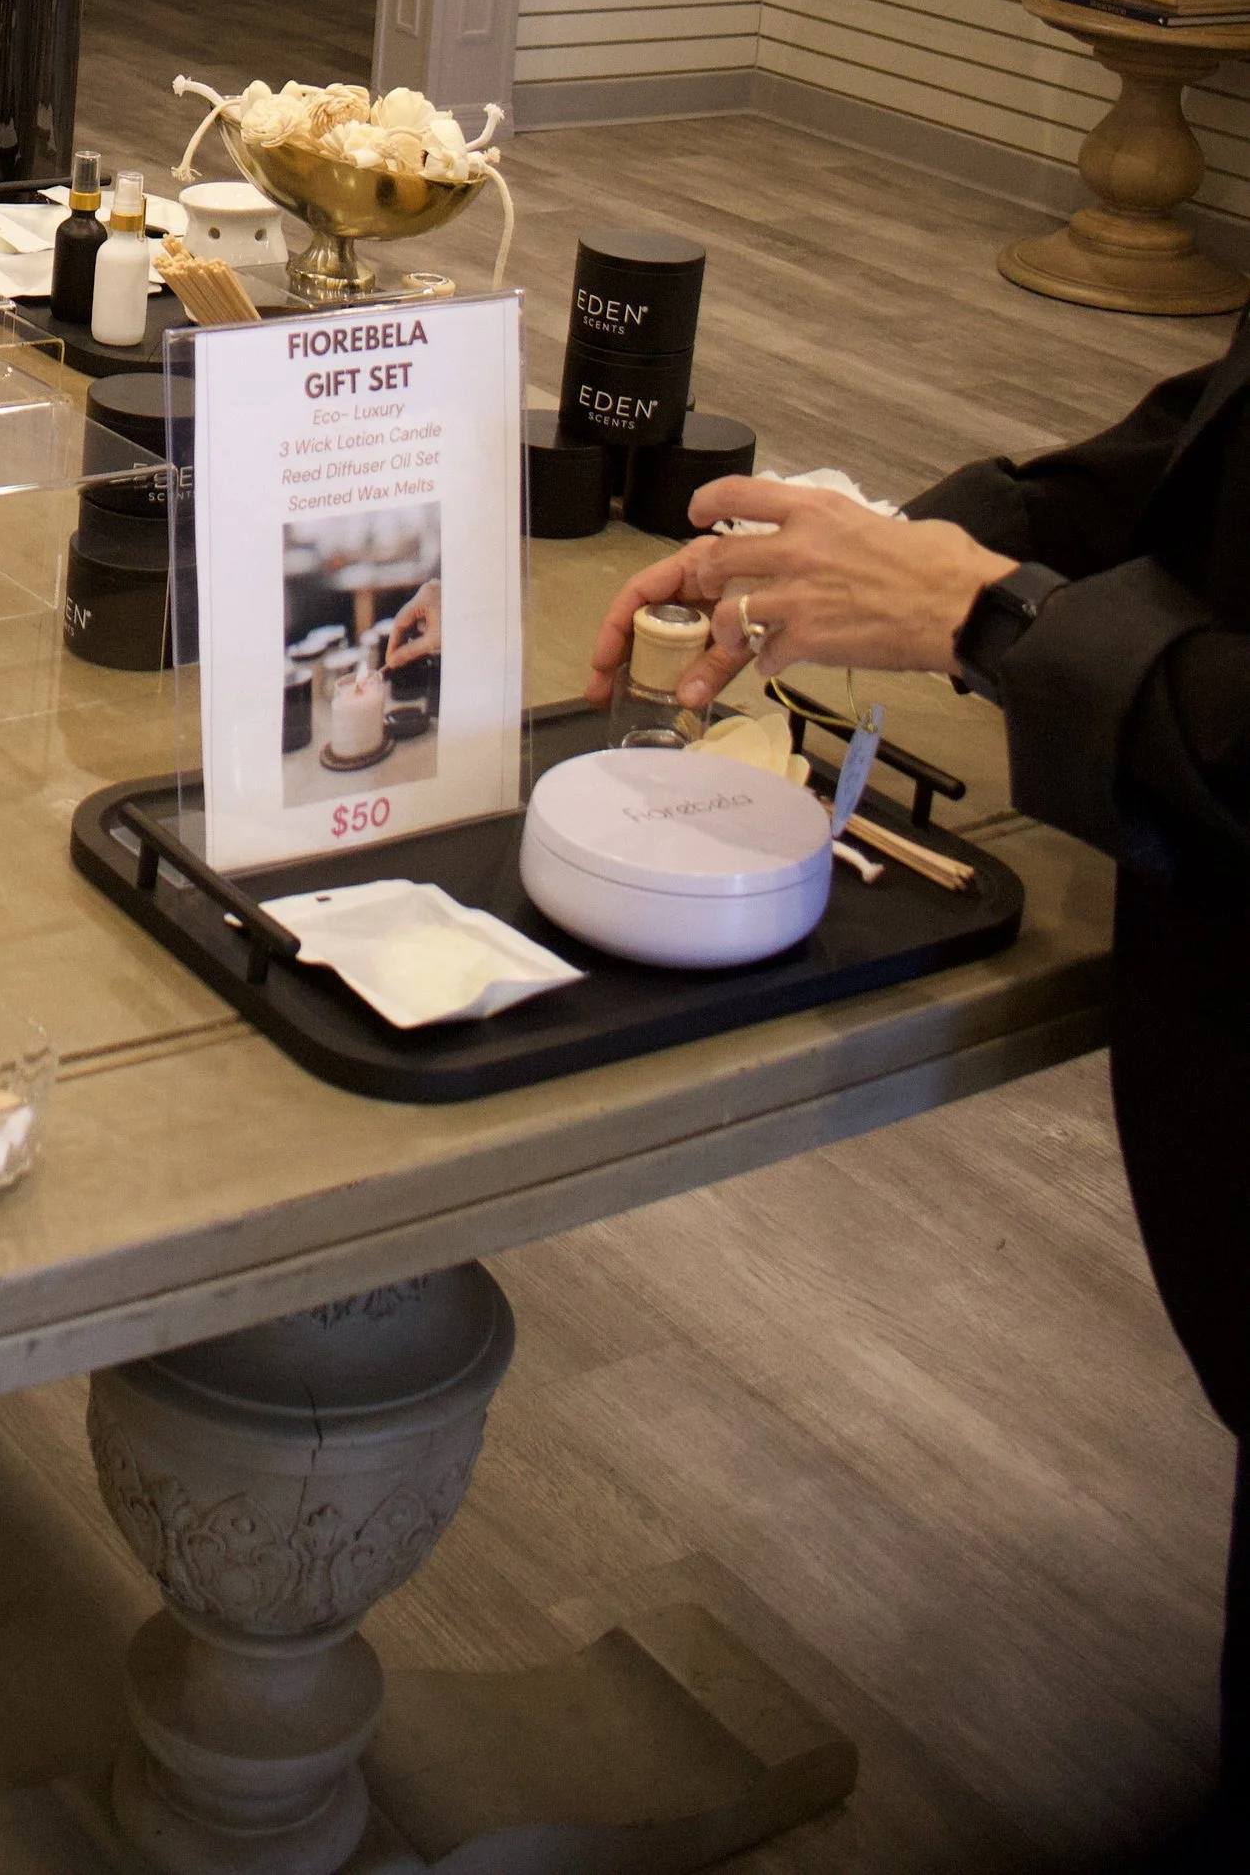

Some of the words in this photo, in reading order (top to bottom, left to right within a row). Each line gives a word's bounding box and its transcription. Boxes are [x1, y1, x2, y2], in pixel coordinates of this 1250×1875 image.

[287, 318, 428, 360] FIOREBELA
[582, 316, 626, 336] SCENTS
[305, 368, 361, 399] GIFT
[368, 361, 414, 392] SET
[353, 400, 406, 424] Luxury
[587, 410, 636, 430] SCENTS
[279, 439, 290, 458] 3
[294, 433, 334, 456] Wick
[336, 428, 385, 452] Lotion
[387, 422, 442, 447] Candle
[281, 463, 323, 486] Reed
[326, 456, 387, 481] Diffuser
[391, 453, 411, 473] Oil
[415, 448, 441, 469] Set
[287, 487, 353, 511] Scented
[356, 482, 390, 503] Wax
[393, 476, 435, 498] Melts
[331, 796, 391, 838] $50
